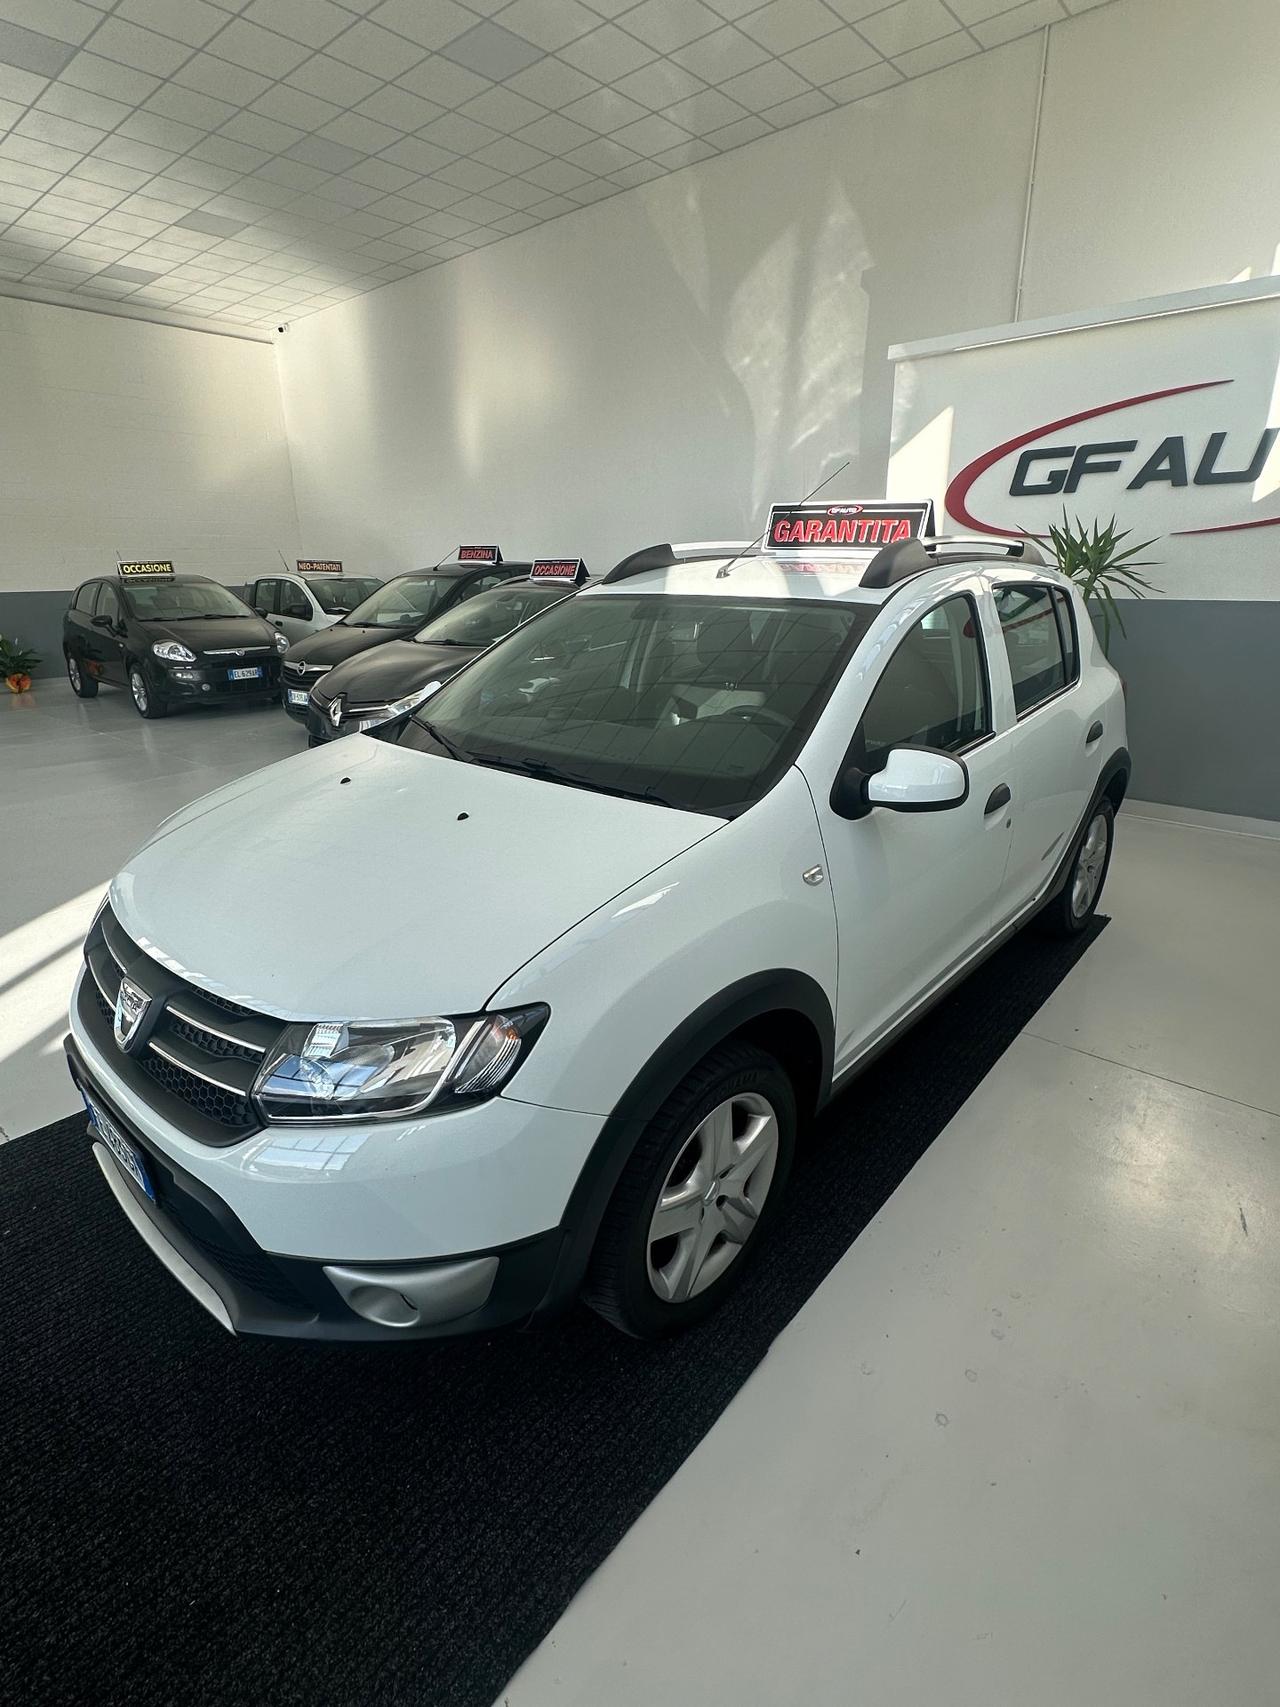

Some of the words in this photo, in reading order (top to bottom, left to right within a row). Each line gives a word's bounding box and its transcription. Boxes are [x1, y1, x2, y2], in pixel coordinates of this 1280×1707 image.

[774, 519, 911, 544] GARANTITA
[460, 549, 493, 560] BENZINA
[122, 563, 172, 574] OCCASIONE
[533, 564, 576, 576] OCCASIONE
